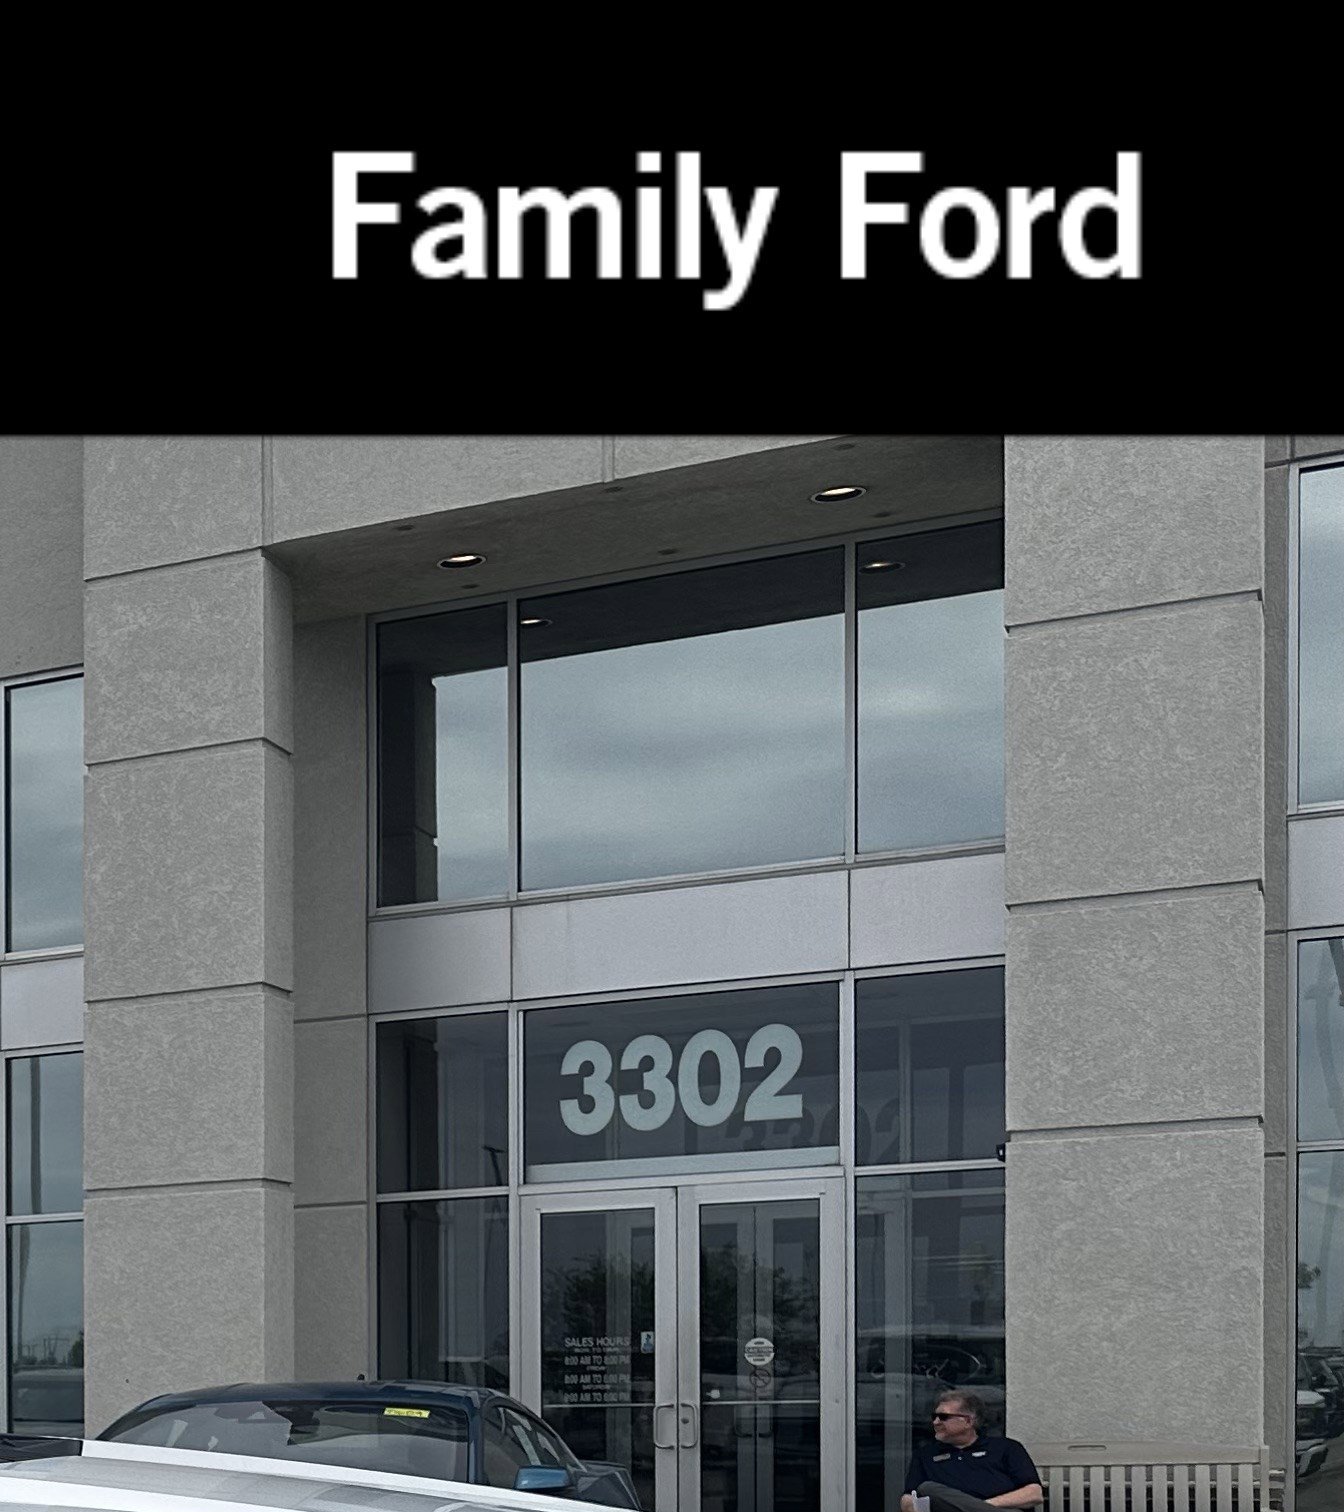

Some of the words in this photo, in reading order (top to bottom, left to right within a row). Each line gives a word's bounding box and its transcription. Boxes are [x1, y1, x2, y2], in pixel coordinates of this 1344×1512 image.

[559, 1022, 805, 1138] 3302
[564, 1336, 594, 1348] SALES
[596, 1336, 631, 1347] HOURS
[592, 1355, 603, 1365] TO
[592, 1374, 602, 1384] TO
[592, 1392, 603, 1402] TO
